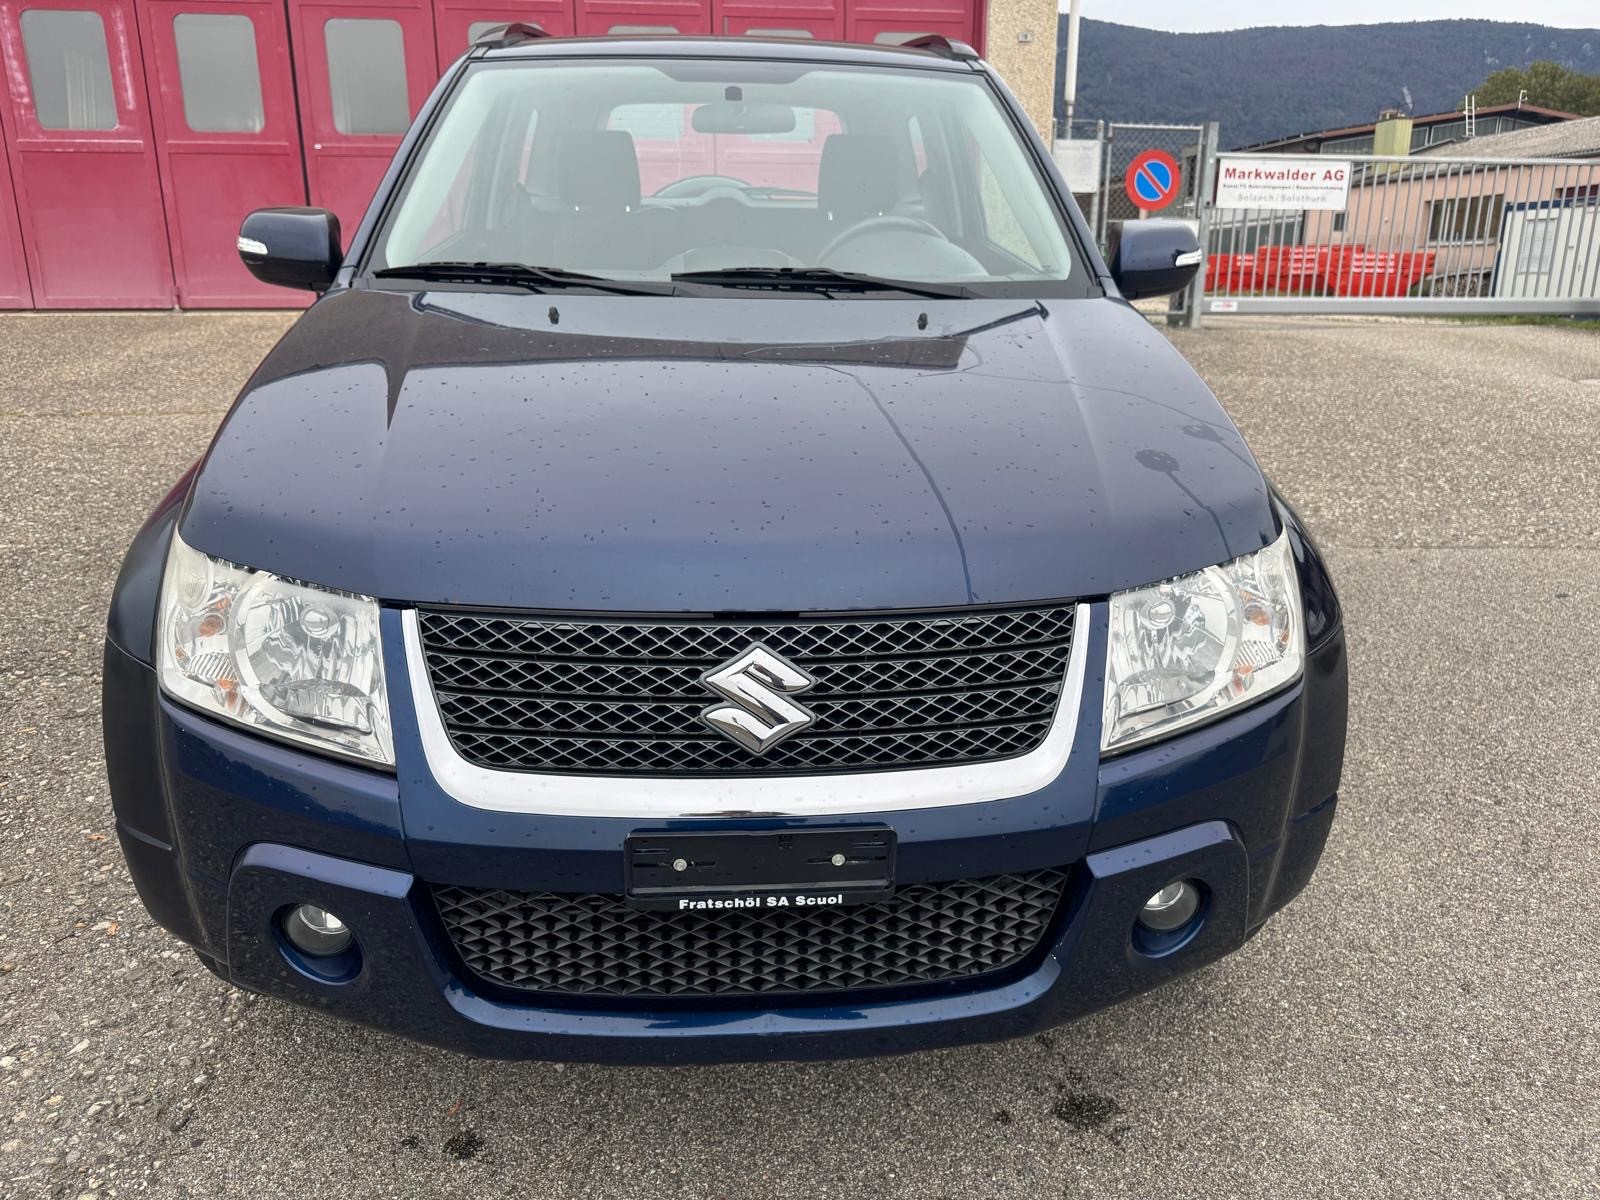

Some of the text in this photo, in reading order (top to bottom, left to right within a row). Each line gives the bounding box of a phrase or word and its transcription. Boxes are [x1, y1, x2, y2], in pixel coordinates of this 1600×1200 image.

[1224, 167, 1344, 181] Markwalder AG
[679, 894, 843, 910] Fratschöl SA Scuol
